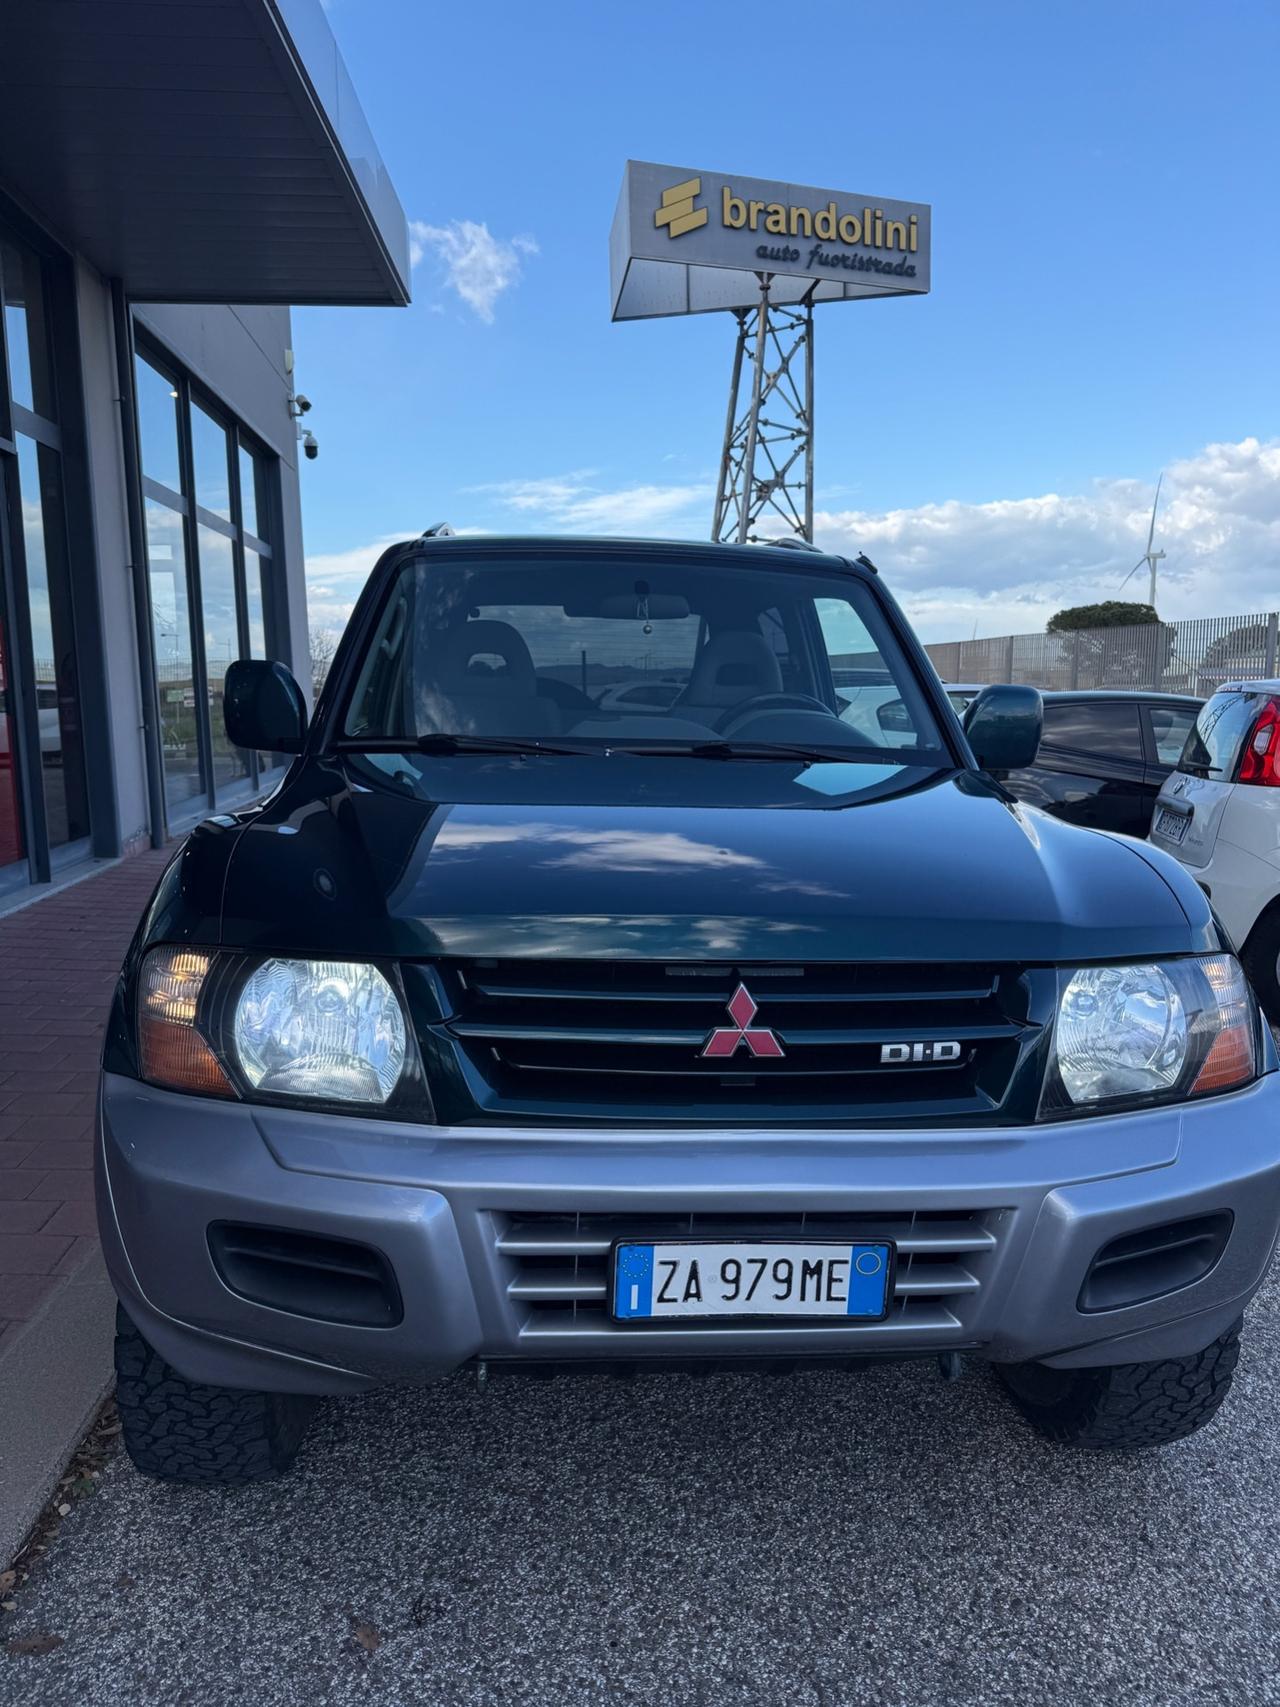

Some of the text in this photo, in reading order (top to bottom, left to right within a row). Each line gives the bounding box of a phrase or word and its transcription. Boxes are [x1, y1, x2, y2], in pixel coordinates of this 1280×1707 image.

[722, 185, 919, 252] brandolini
[755, 243, 917, 278] auto fuoristrada
[656, 1258, 850, 1303] ZA 979ME
